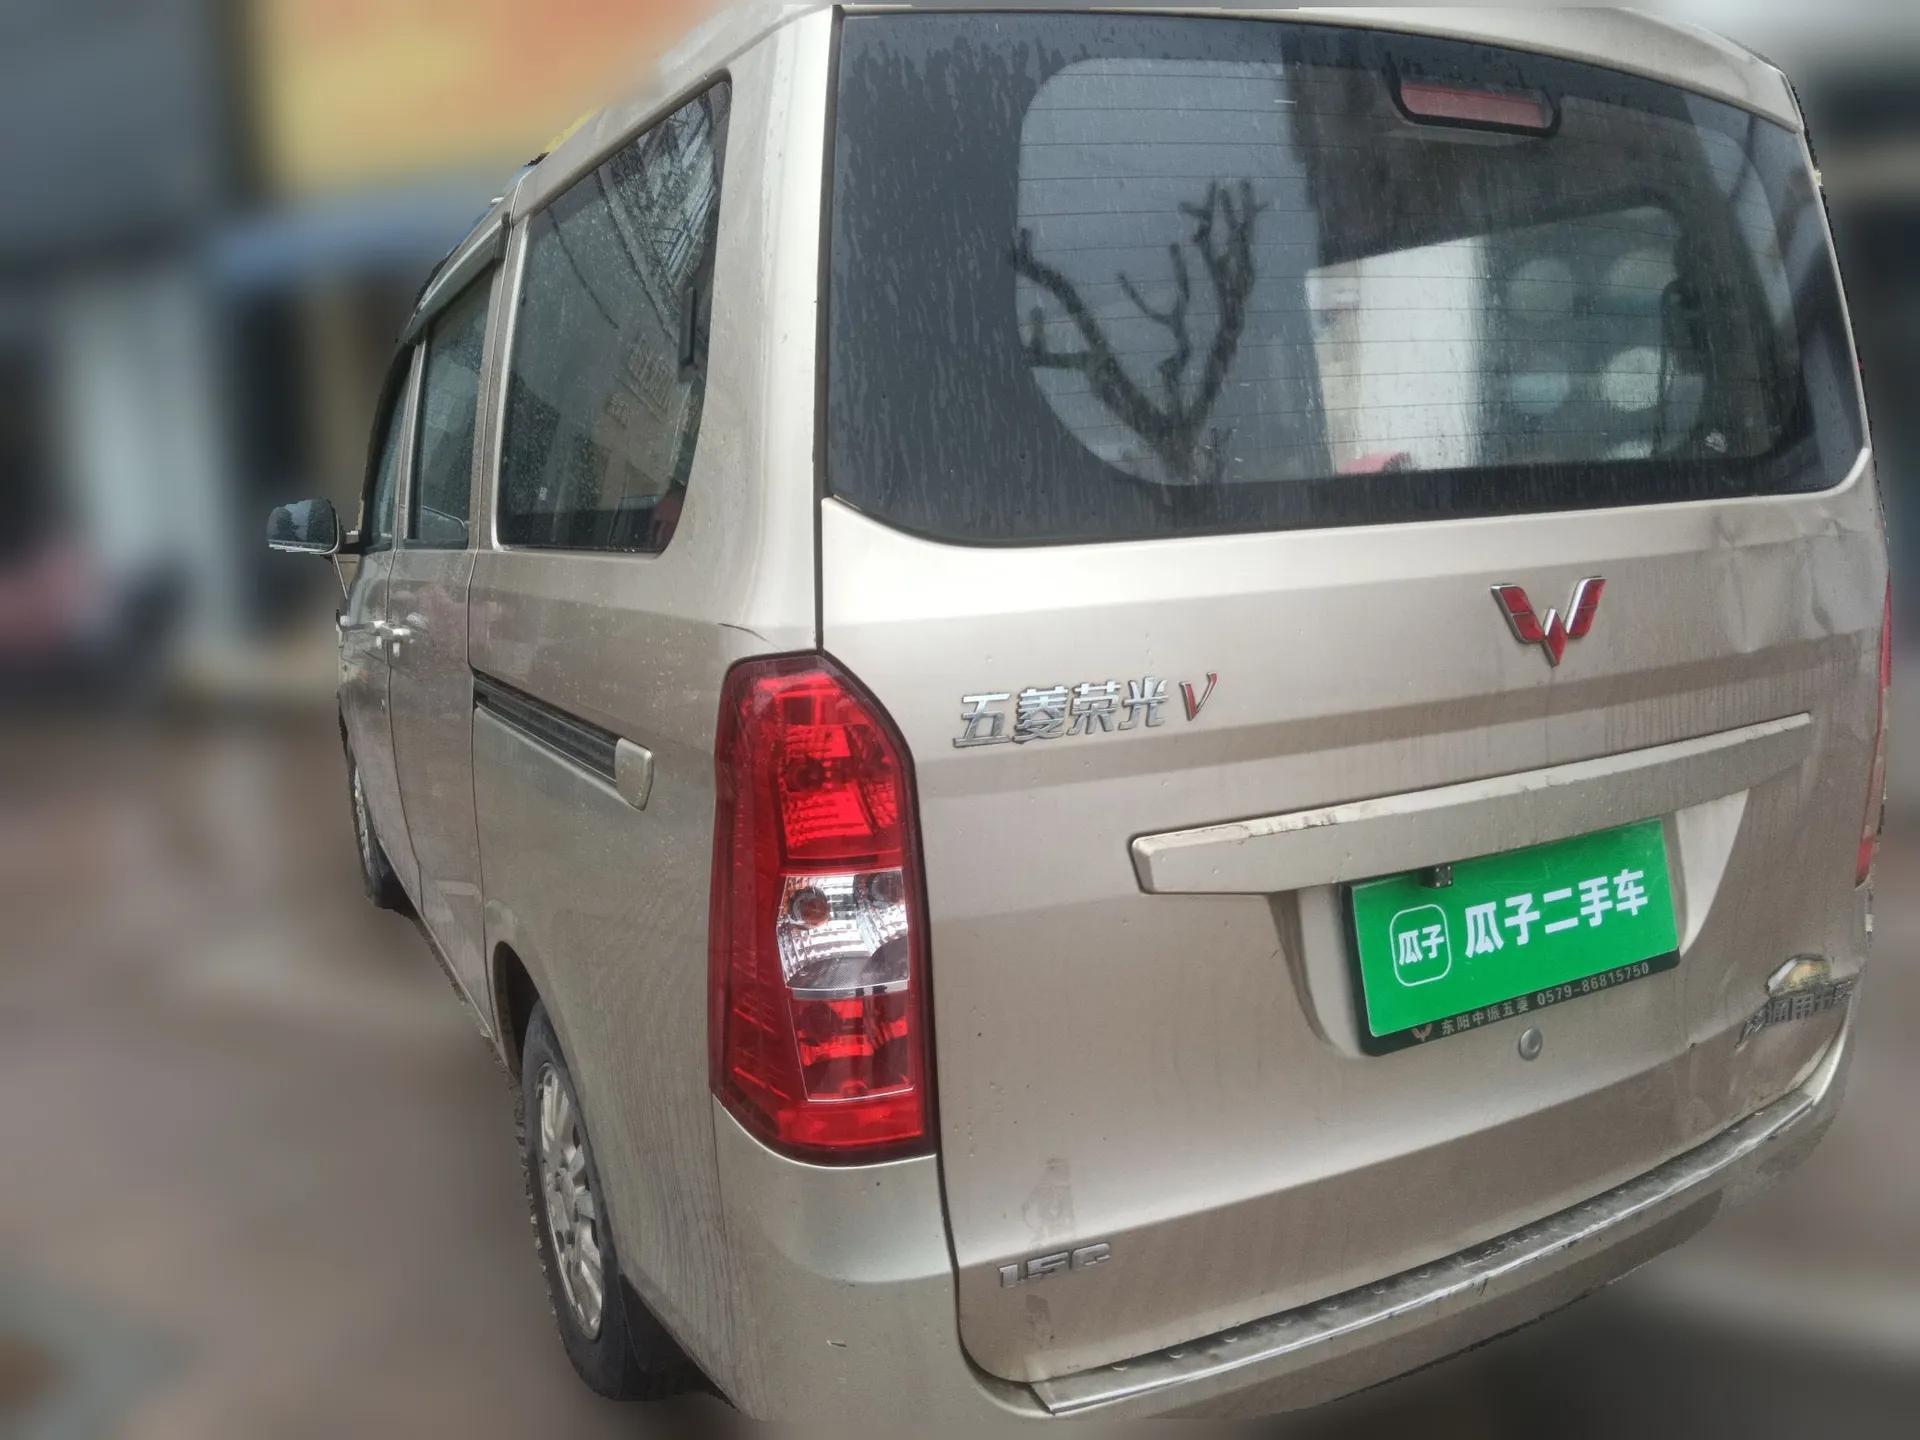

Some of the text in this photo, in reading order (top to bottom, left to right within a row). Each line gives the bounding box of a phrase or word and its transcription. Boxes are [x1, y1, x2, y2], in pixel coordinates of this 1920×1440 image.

[1465, 869, 1649, 958] 瓜子二手车
[1397, 924, 1445, 966] 瓜子
[1536, 961, 1650, 1006] 0579-86815750
